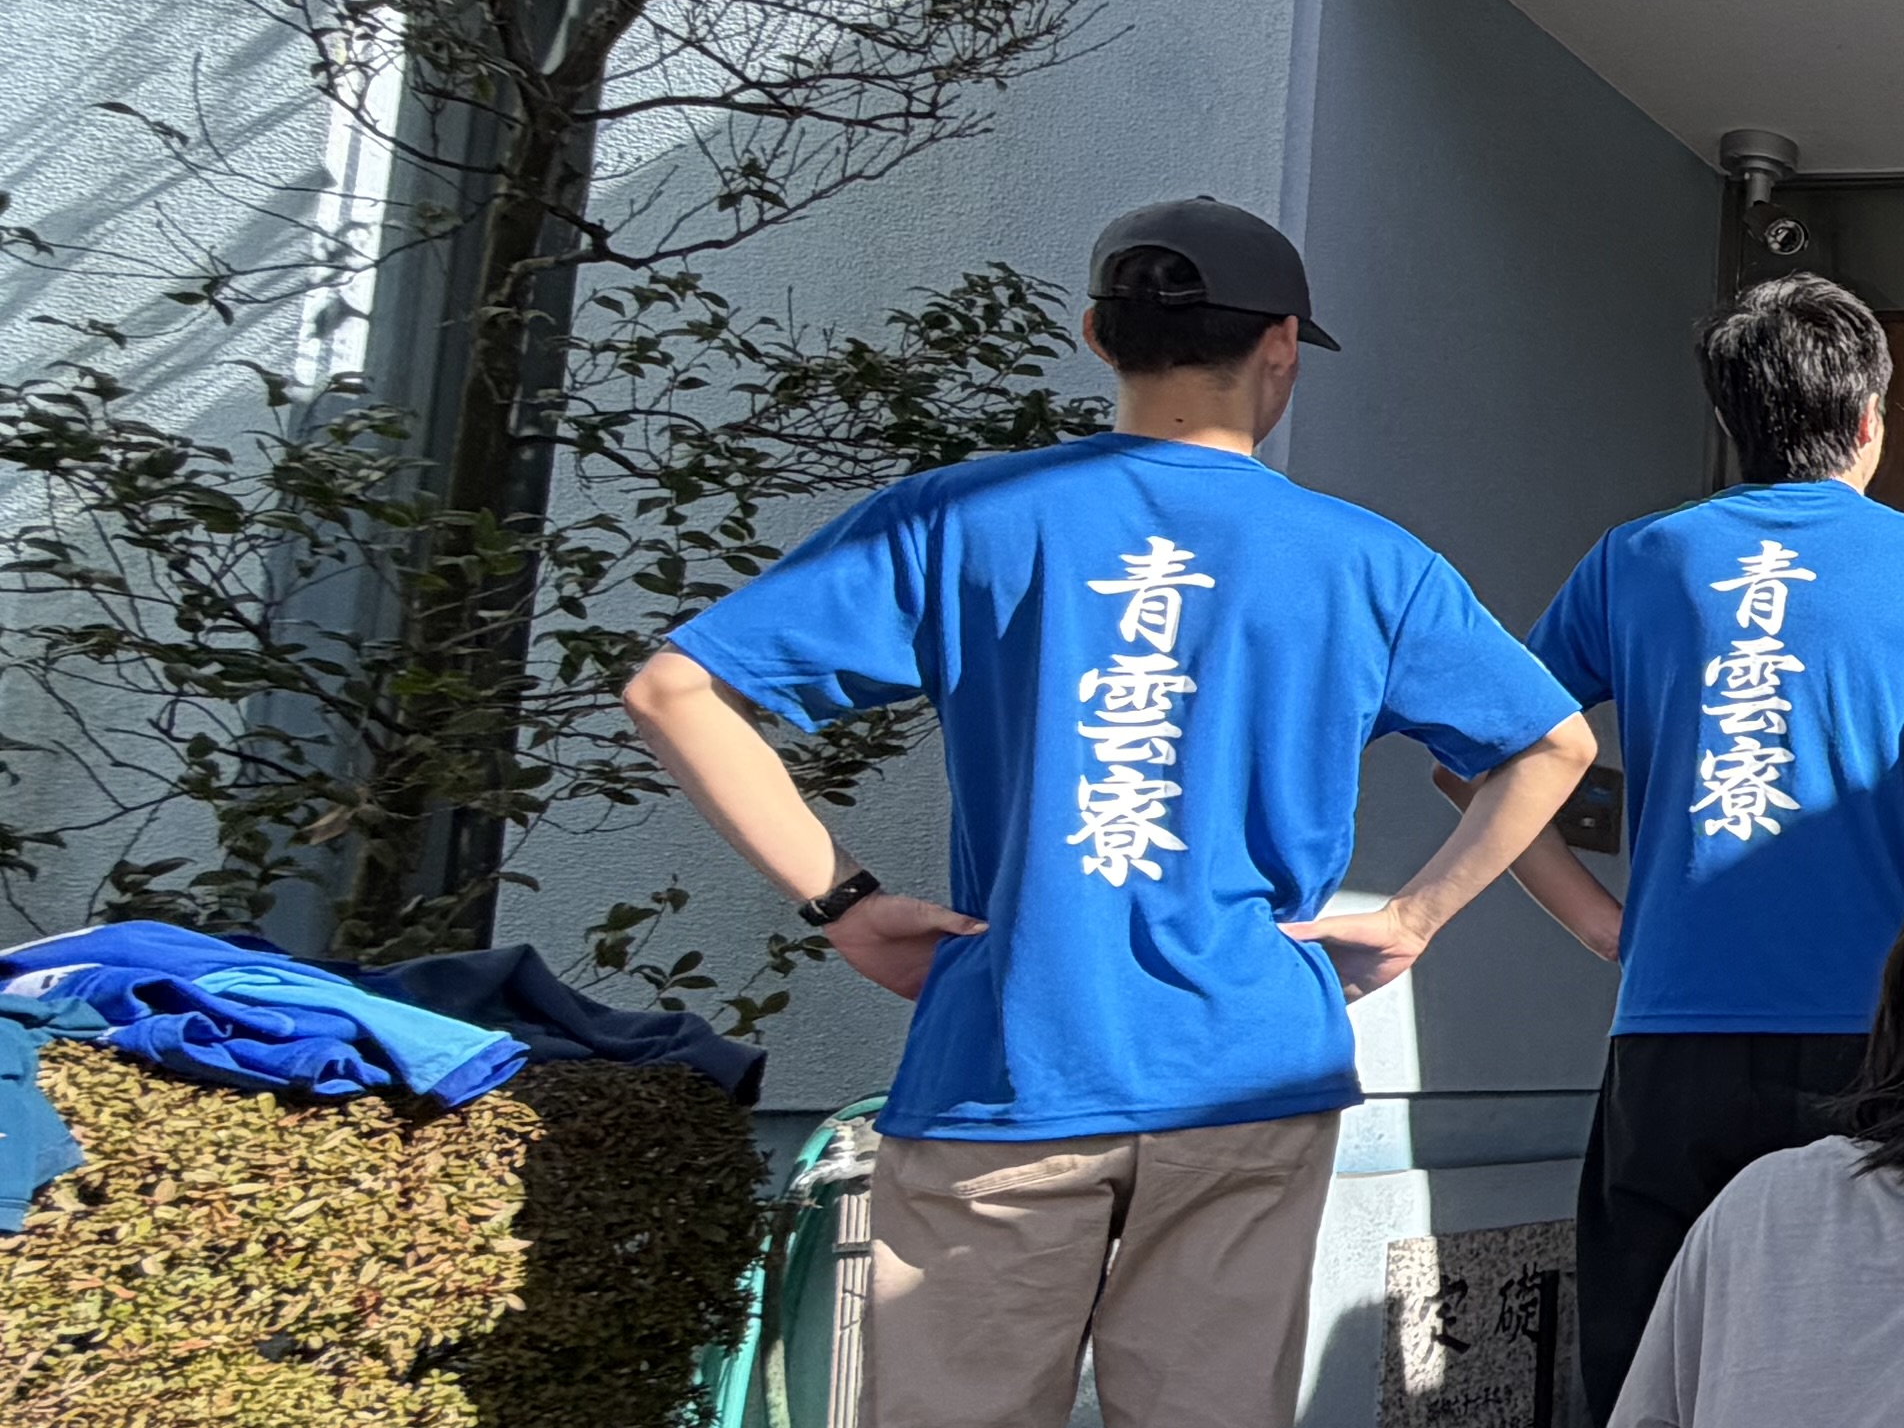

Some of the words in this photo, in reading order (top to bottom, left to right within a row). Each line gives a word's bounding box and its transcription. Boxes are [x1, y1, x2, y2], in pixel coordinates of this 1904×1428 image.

[1065, 535, 1216, 888] 青雲寮
[1689, 539, 1817, 842] 青雲寮
